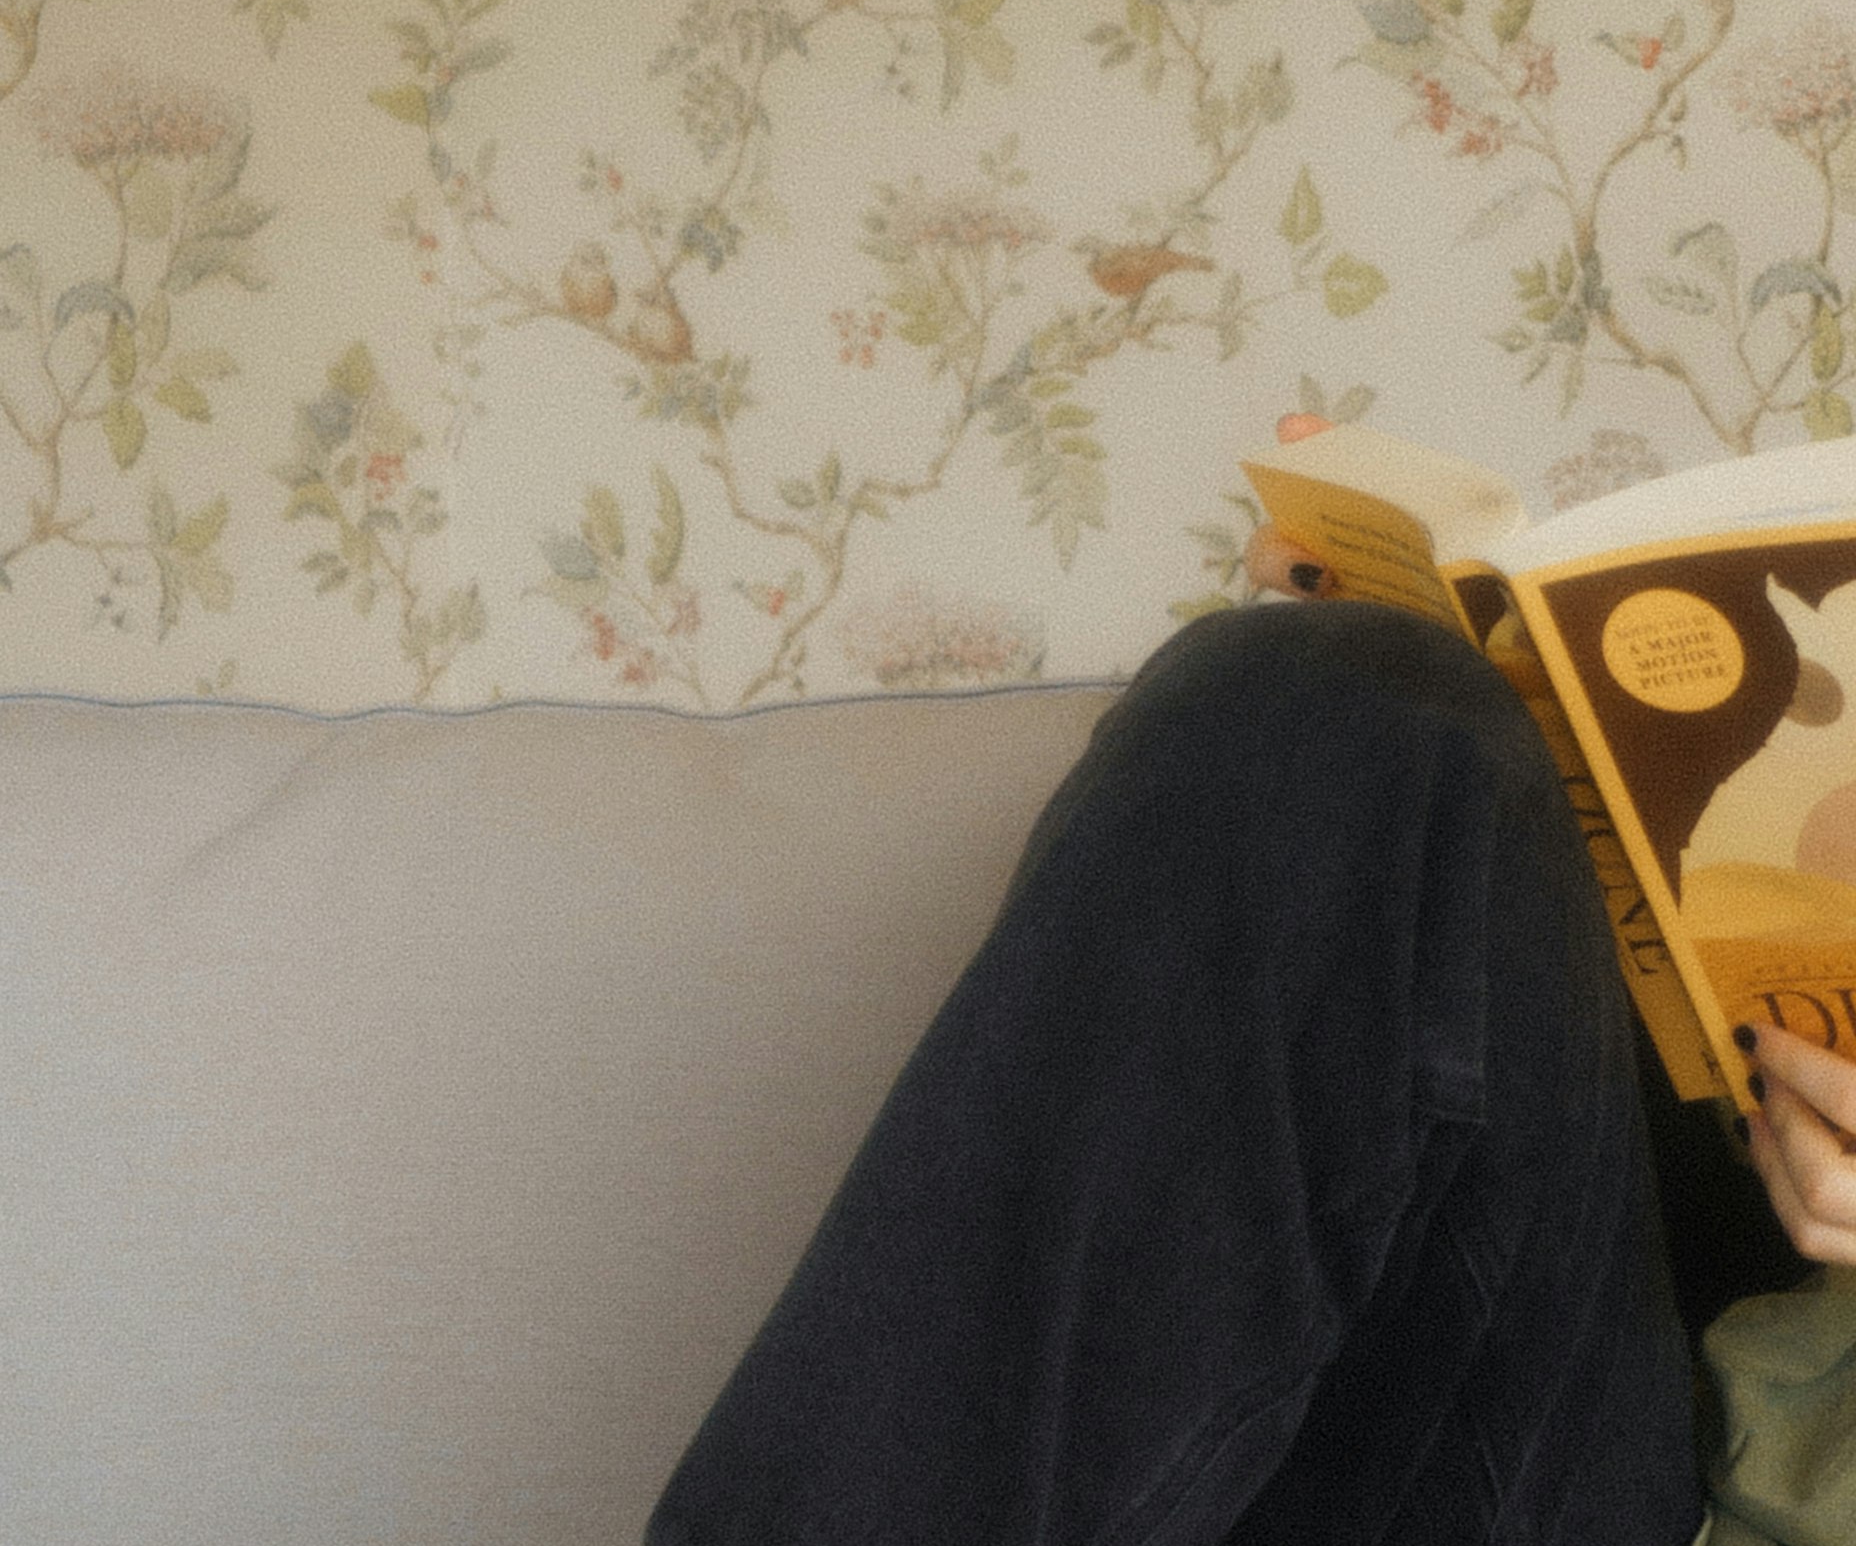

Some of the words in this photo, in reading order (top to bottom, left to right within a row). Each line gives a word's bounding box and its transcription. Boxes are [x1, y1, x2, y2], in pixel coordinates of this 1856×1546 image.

[1647, 630, 1712, 651] MAJOR
[1636, 648, 1719, 671] MOTION
[1639, 664, 1728, 690] PICTURE
